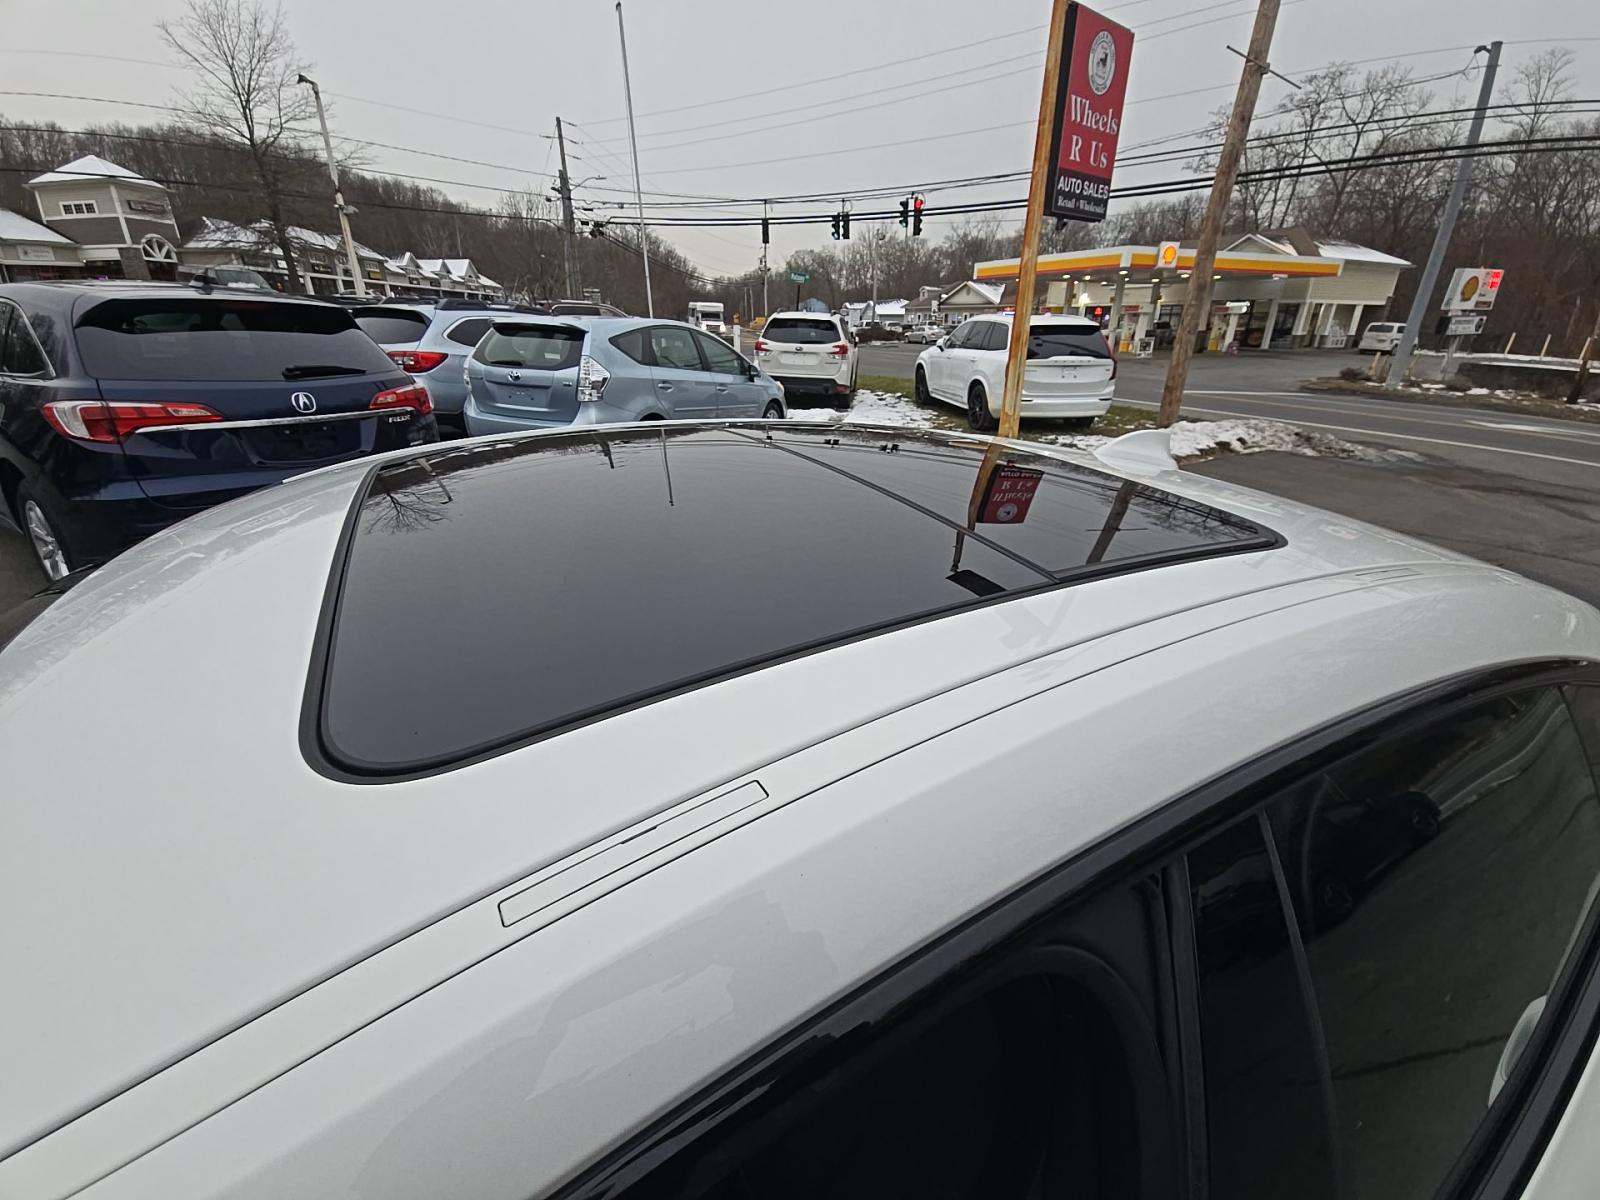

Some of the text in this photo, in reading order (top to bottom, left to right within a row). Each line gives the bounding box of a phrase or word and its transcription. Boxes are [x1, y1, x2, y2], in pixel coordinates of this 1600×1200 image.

[1070, 95, 1118, 135] Wheels
[1069, 135, 1108, 169] R Us
[1057, 175, 1109, 199] AUTO SALES
